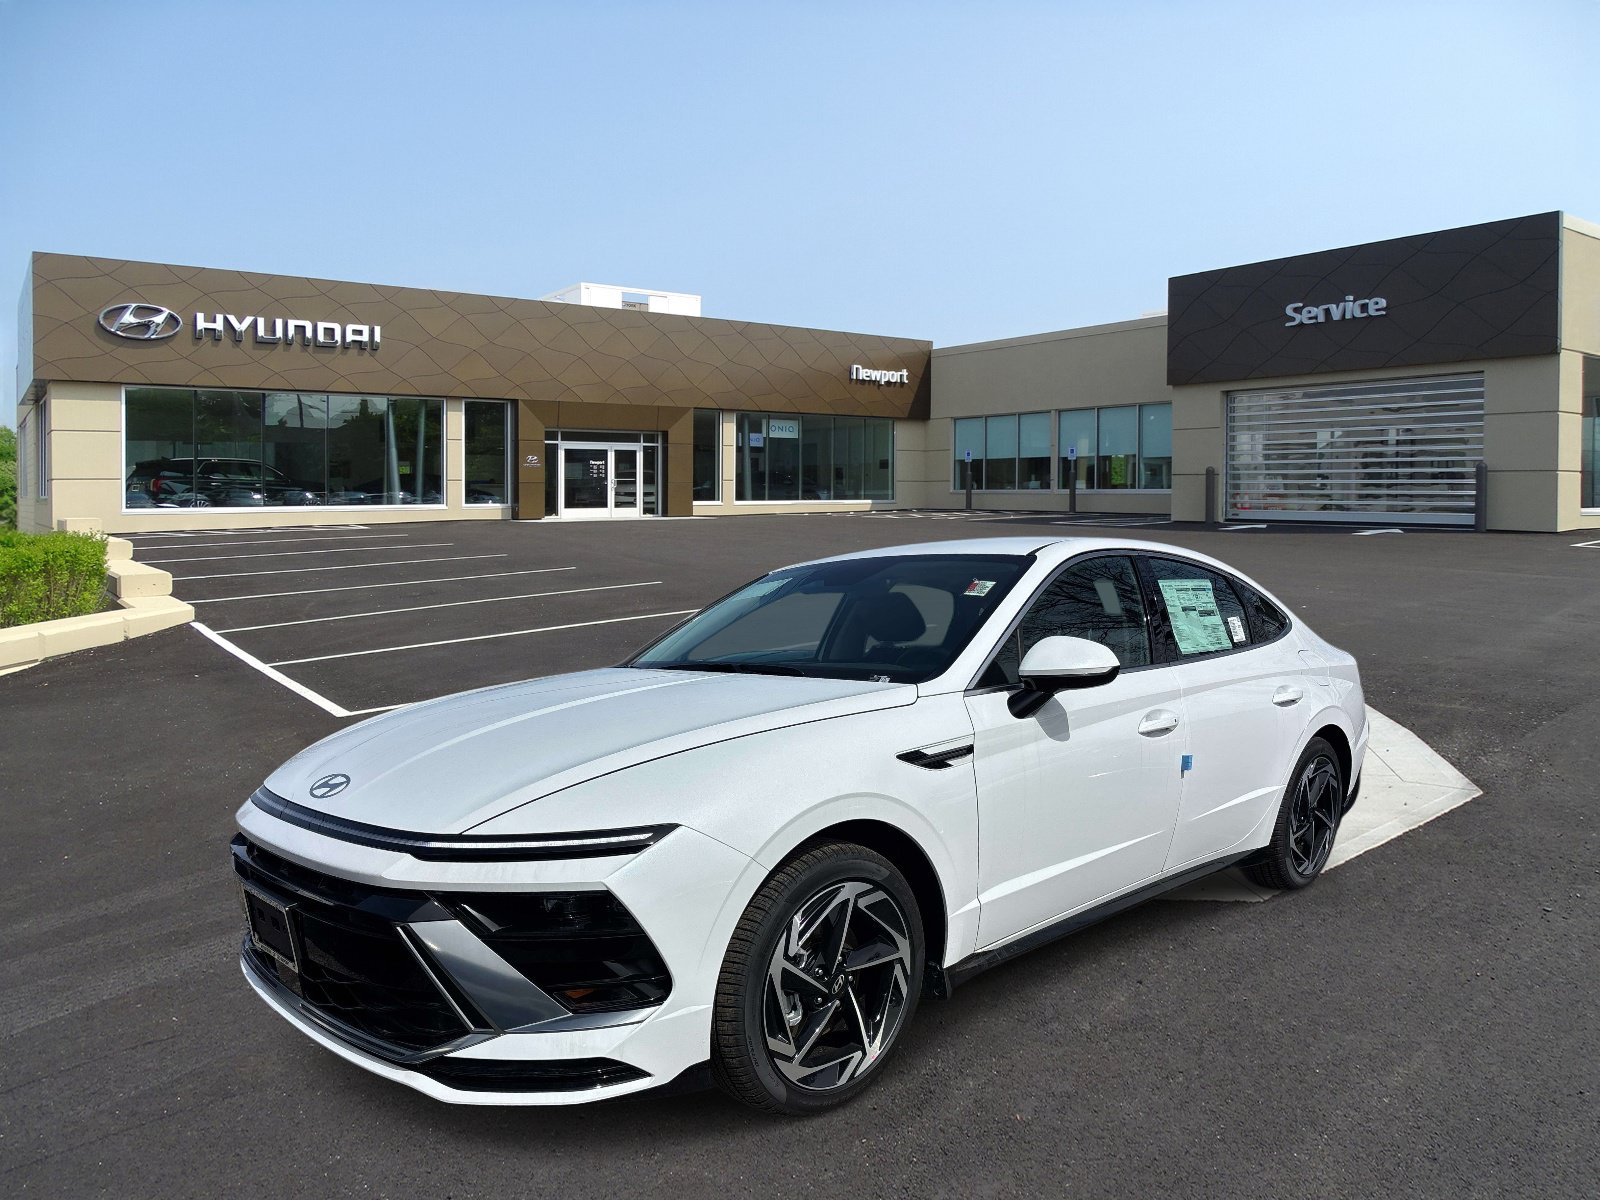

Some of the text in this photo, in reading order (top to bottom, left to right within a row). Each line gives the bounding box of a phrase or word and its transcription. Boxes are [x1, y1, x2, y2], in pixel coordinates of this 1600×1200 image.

[1284, 295, 1387, 327] Service
[195, 312, 381, 350] HYUNDAI
[850, 364, 909, 385] Newport
